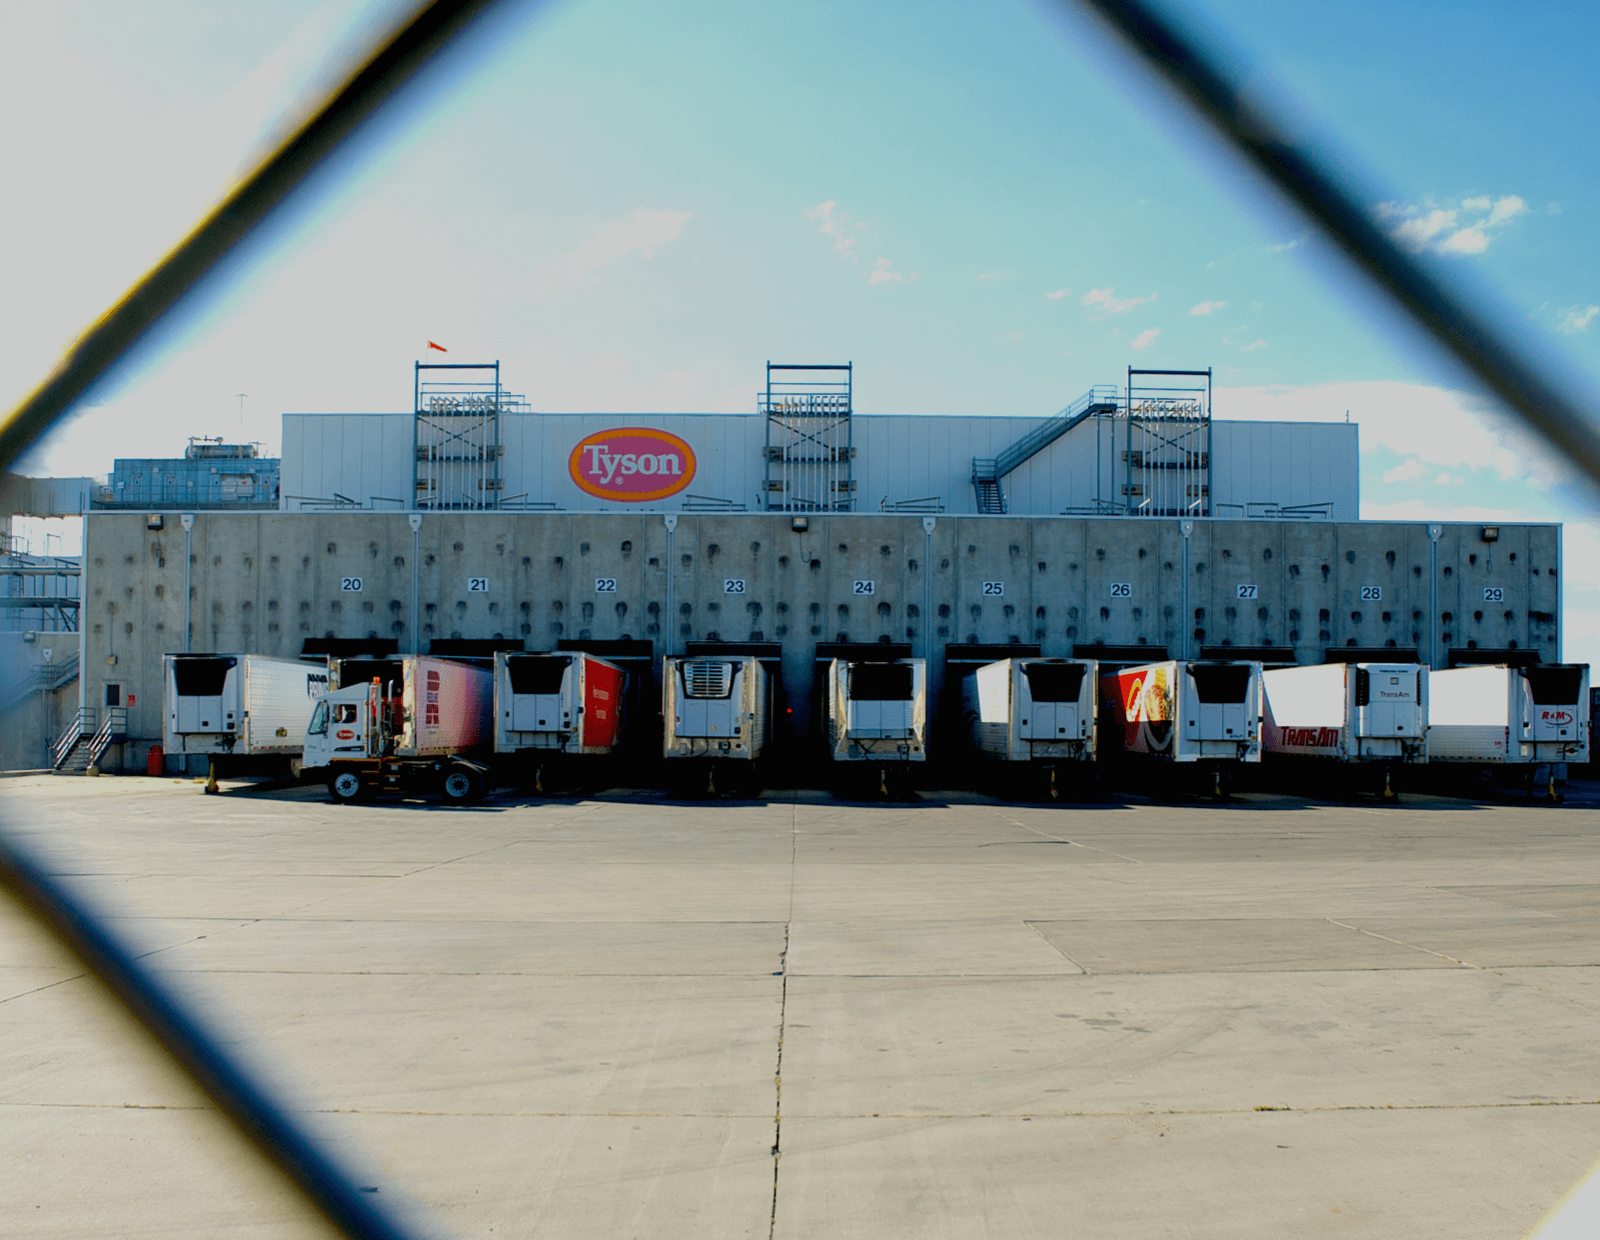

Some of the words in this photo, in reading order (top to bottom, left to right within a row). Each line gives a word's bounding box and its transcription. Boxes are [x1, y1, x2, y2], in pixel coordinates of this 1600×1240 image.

[583, 445, 681, 485] Tyson
[343, 579, 361, 590] 20
[471, 579, 486, 590] 21
[597, 580, 615, 591] 22
[726, 581, 744, 592] 23
[855, 582, 873, 593] 24
[984, 583, 1003, 594] 25
[1111, 584, 1130, 596] 26
[1239, 586, 1256, 597] 27
[1363, 588, 1381, 599] 28
[1485, 589, 1503, 600] 29
